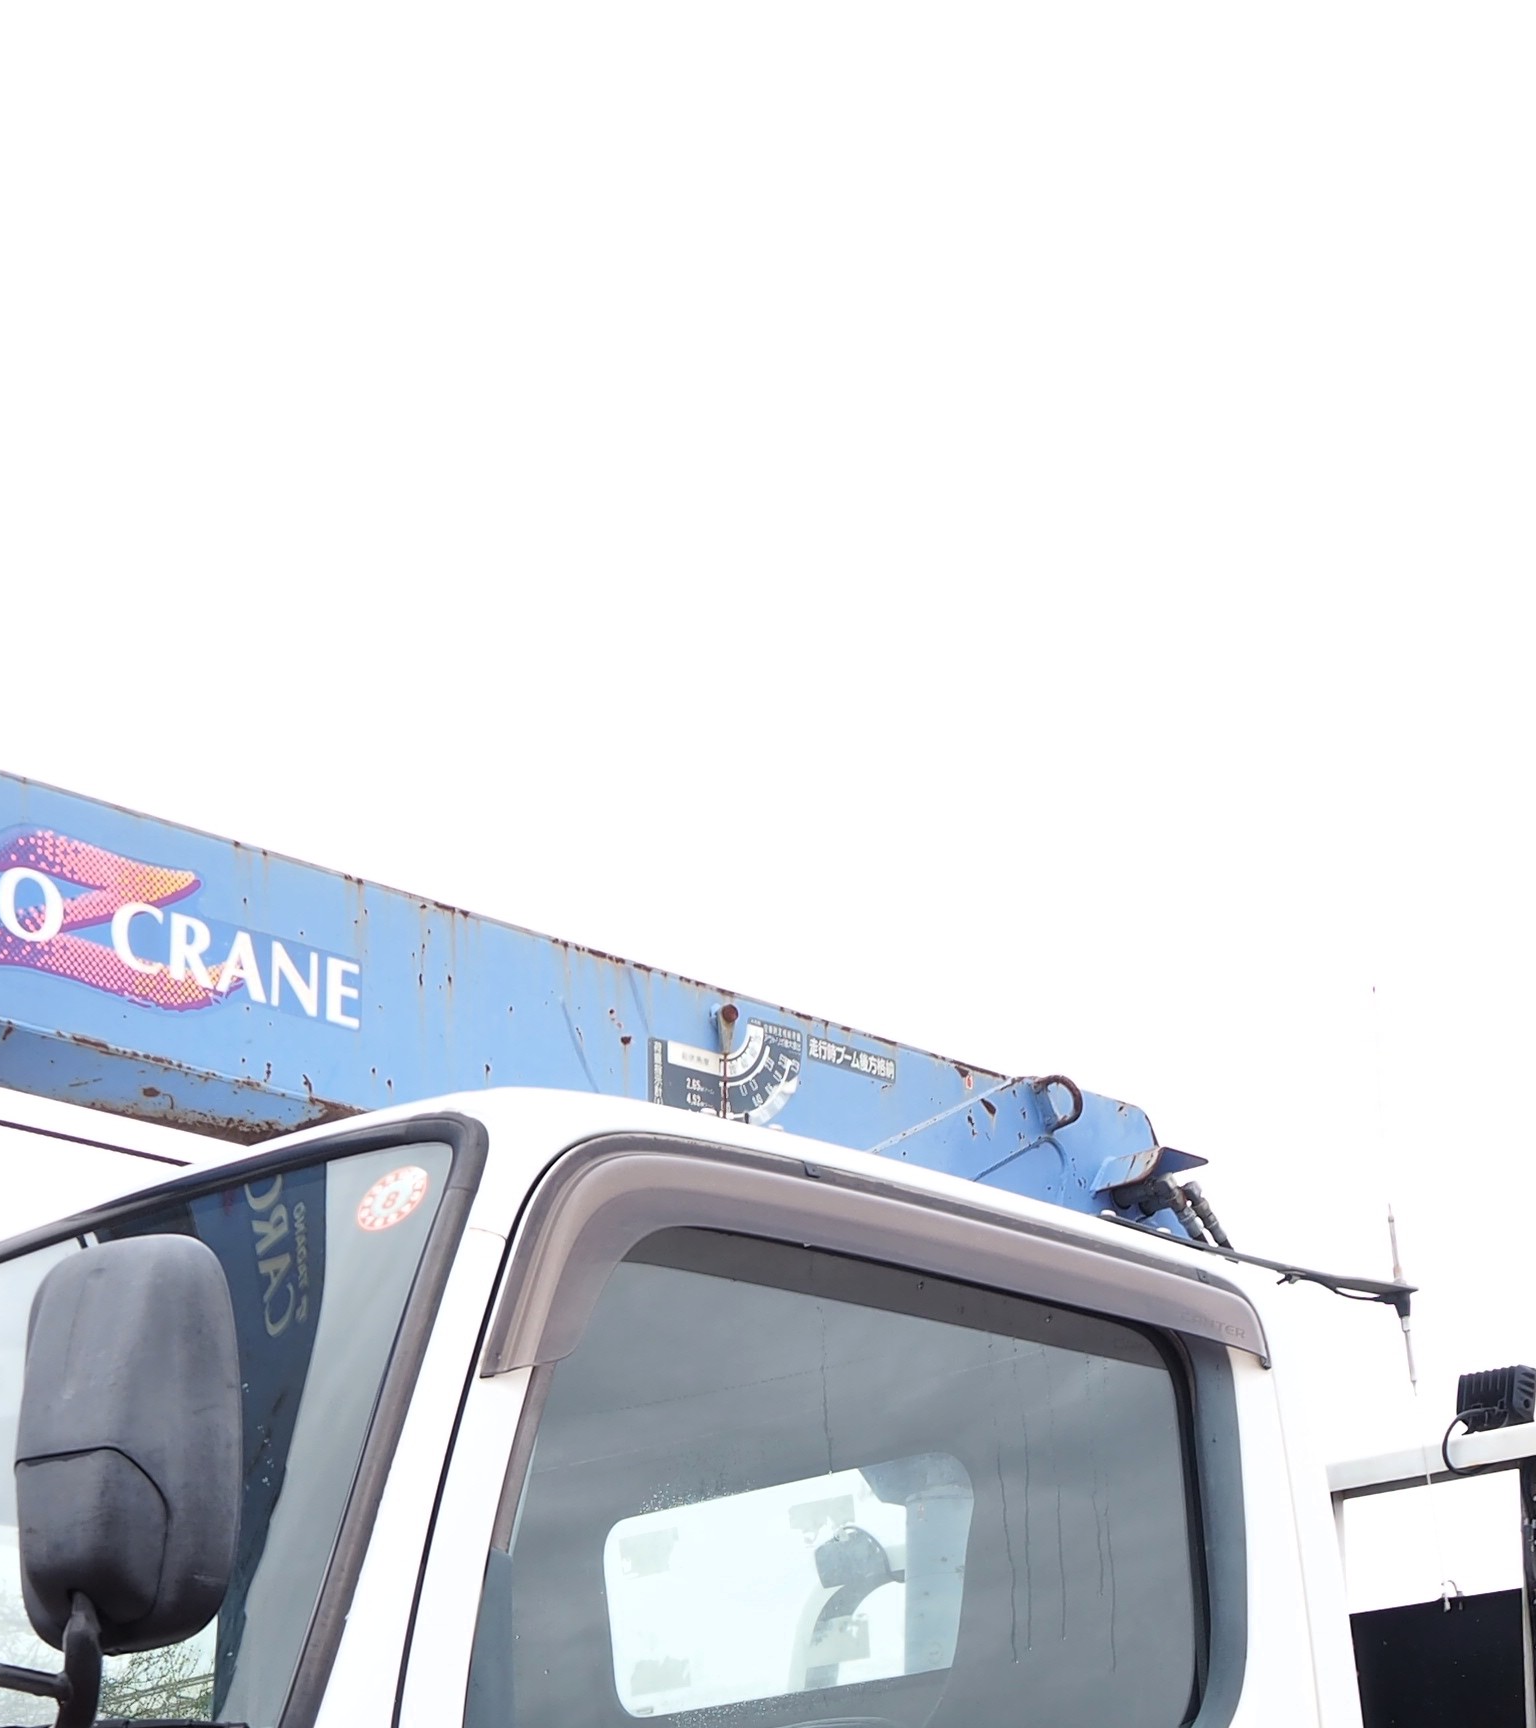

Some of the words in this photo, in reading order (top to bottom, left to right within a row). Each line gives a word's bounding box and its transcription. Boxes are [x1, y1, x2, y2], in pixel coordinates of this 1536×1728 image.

[111, 902, 360, 1029] CRANE
[808, 1037, 895, 1080] 走行時ブーム後方格納
